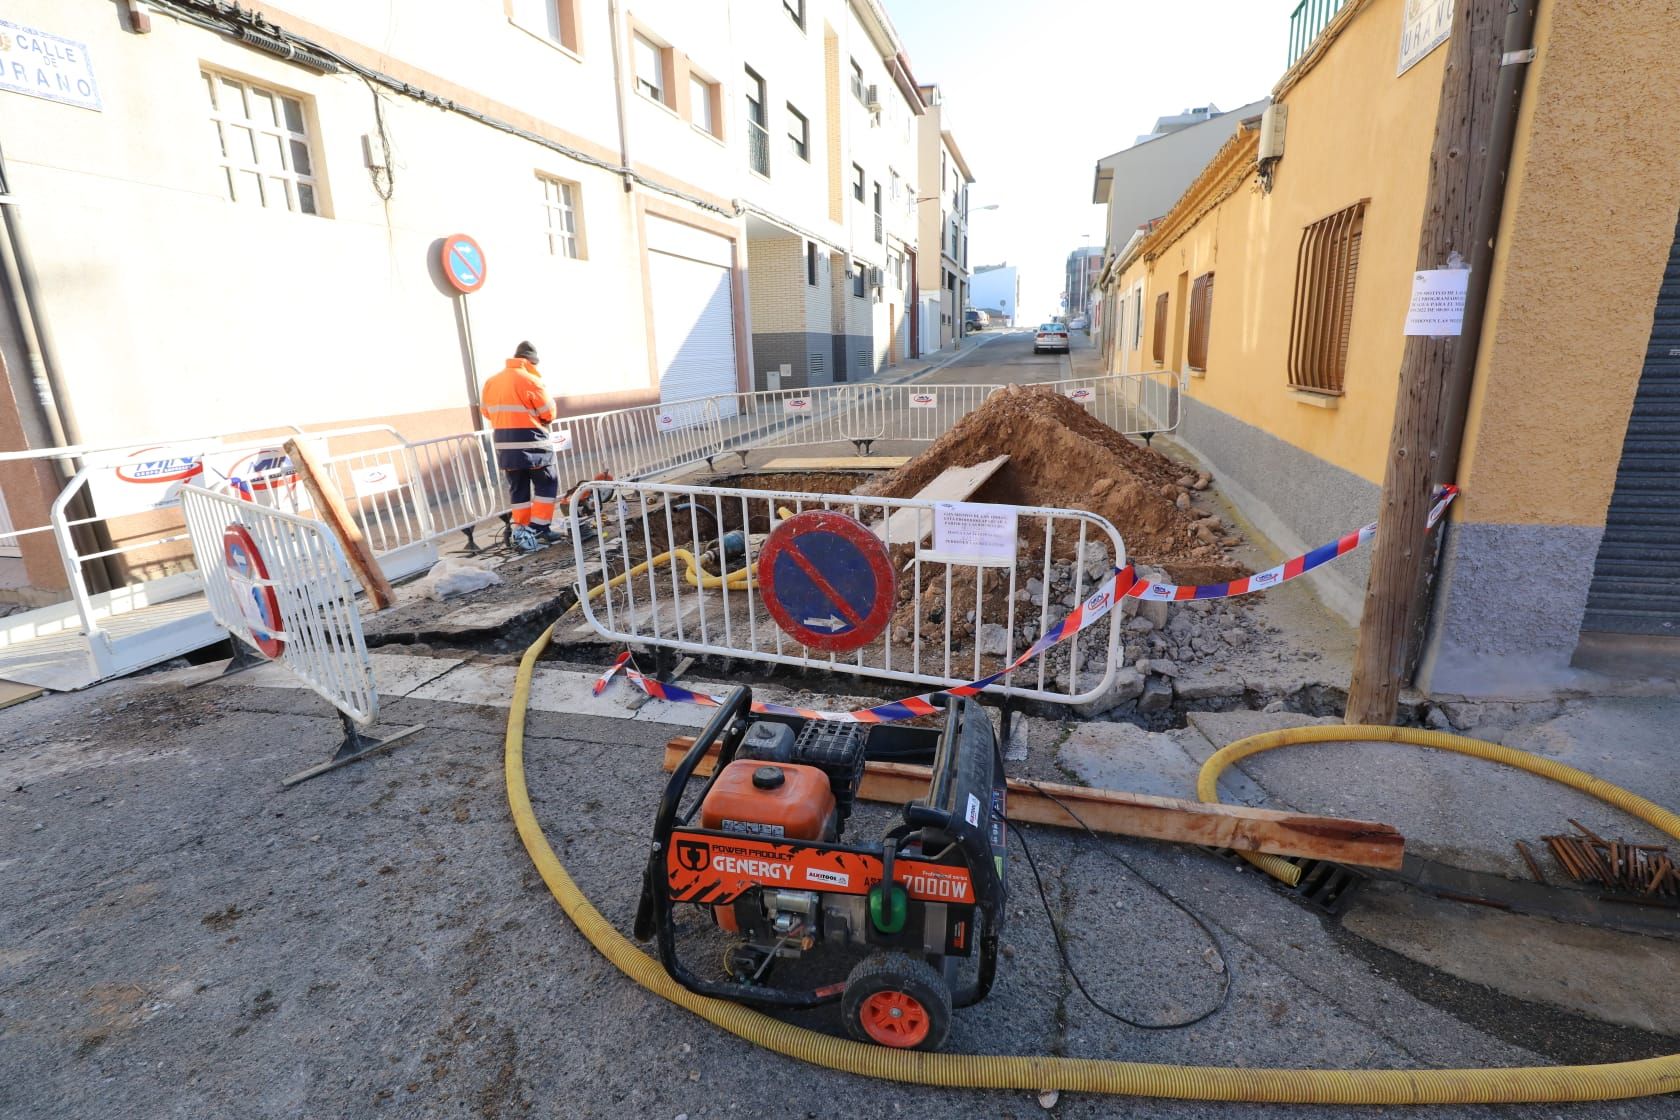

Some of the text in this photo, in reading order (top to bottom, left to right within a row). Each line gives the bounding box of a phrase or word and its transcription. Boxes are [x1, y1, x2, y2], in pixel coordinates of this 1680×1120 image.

[16, 34, 77, 63] CALLE
[43, 55, 58, 68] DE
[712, 844, 794, 861] POWER PRODUCT
[712, 855, 794, 880] GENERGY
[902, 874, 968, 898] 7000W
